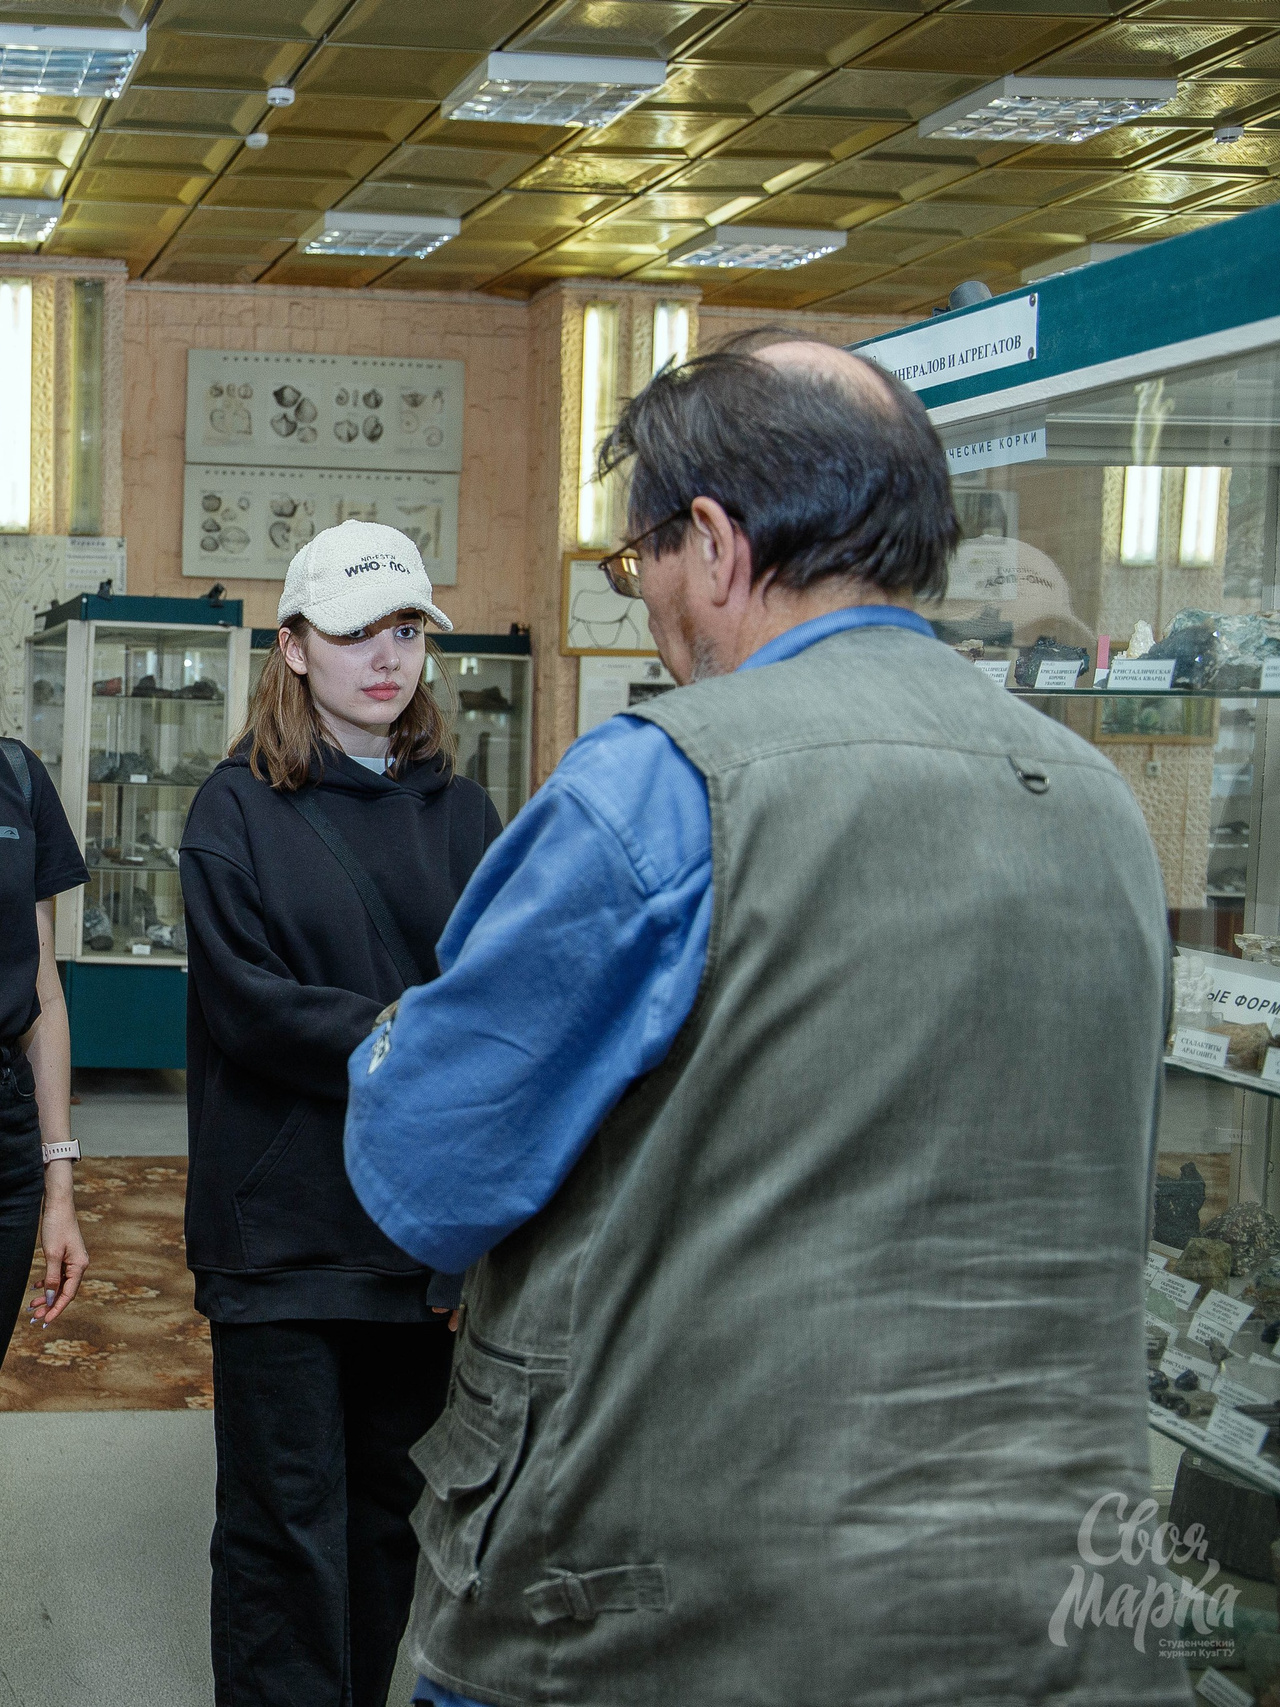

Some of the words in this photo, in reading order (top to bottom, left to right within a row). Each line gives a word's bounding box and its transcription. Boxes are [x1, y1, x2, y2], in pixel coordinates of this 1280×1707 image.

[948, 352, 956, 367] И
[957, 335, 1022, 366] АГРЕГАТОВ
[999, 431, 1037, 450] КОРКИ
[1180, 1037, 1222, 1052] СТАЛАКТИТЫ
[1181, 1046, 1217, 1060] АРАГОНИТА
